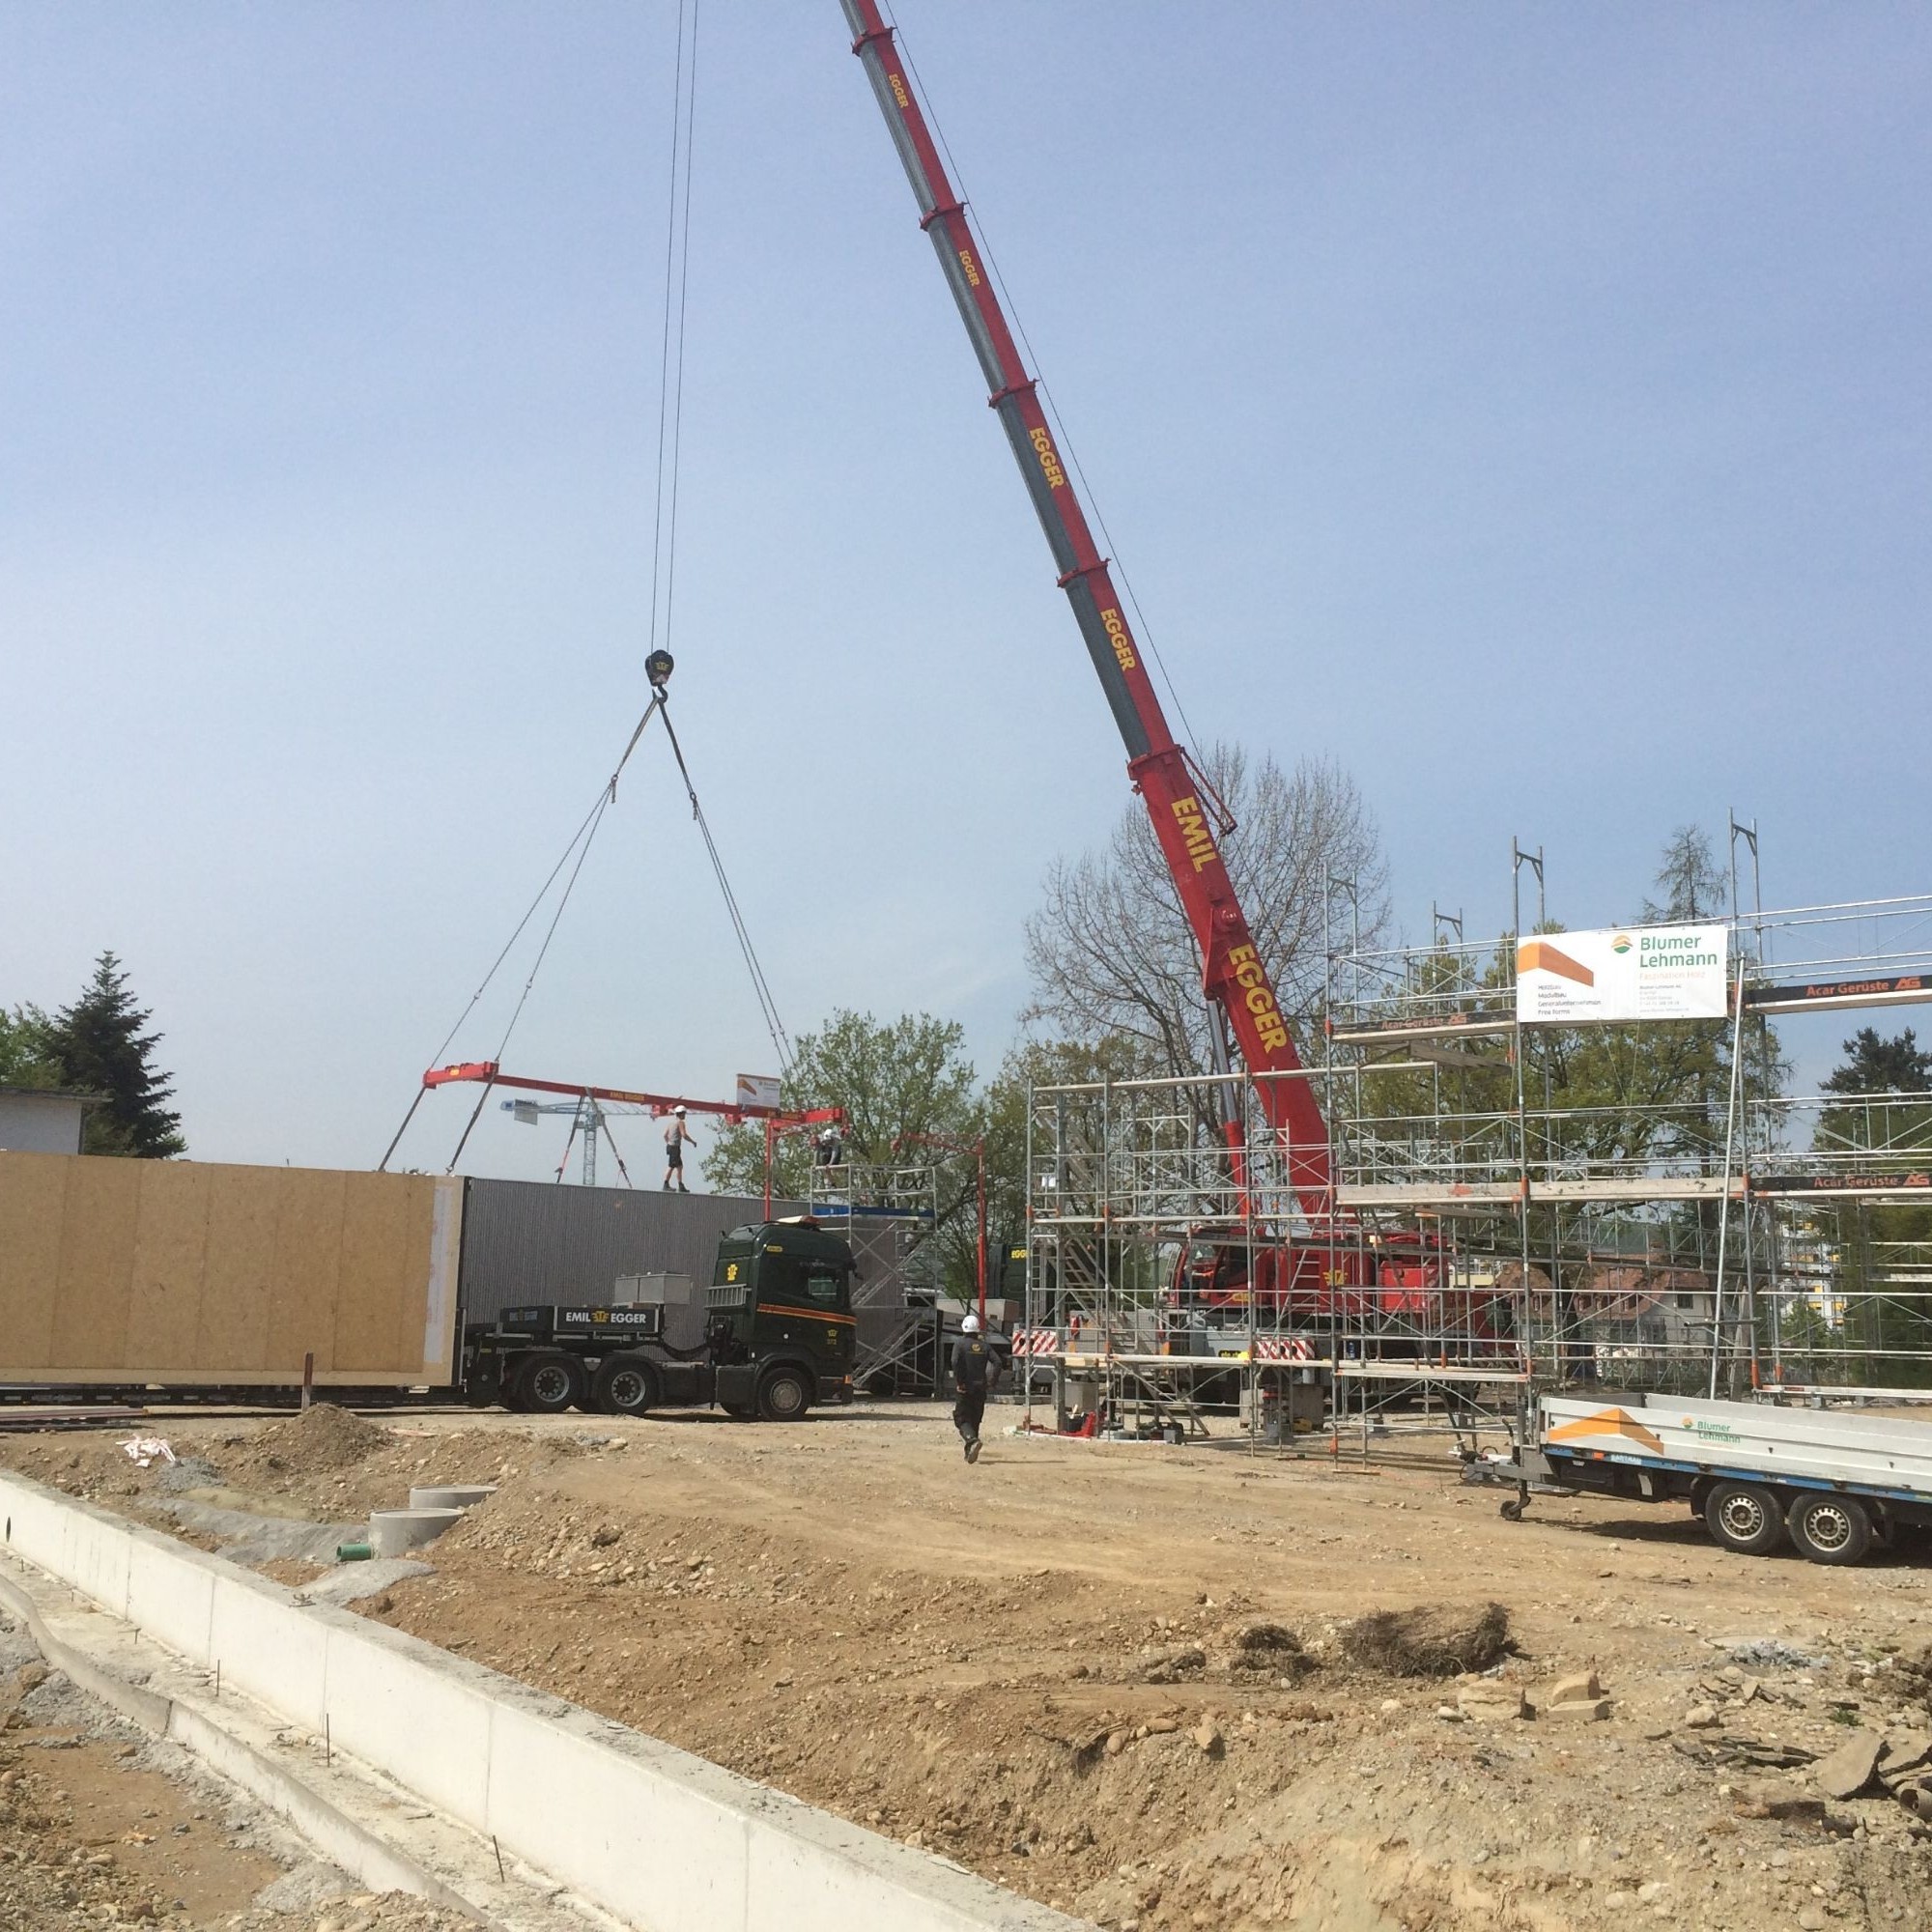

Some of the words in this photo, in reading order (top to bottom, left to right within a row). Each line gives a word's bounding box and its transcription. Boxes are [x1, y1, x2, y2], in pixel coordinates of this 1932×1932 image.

[888, 73, 909, 109] EGGER
[959, 250, 980, 287] EGGER
[1030, 427, 1065, 490] EGGER
[1100, 609, 1136, 671] EGGER
[1171, 796, 1219, 873] EMIL
[1640, 936, 1702, 951] Blumer
[1639, 952, 1718, 968] Lehmann
[1229, 943, 1288, 1054] EGGER
[1806, 984, 1835, 997] Acar
[1837, 980, 1889, 995] Gerüste
[1814, 1177, 1843, 1188] Acar
[565, 1312, 591, 1322] EMIL
[611, 1313, 646, 1323] EGGER
[1697, 1420, 1730, 1433] Blumer
